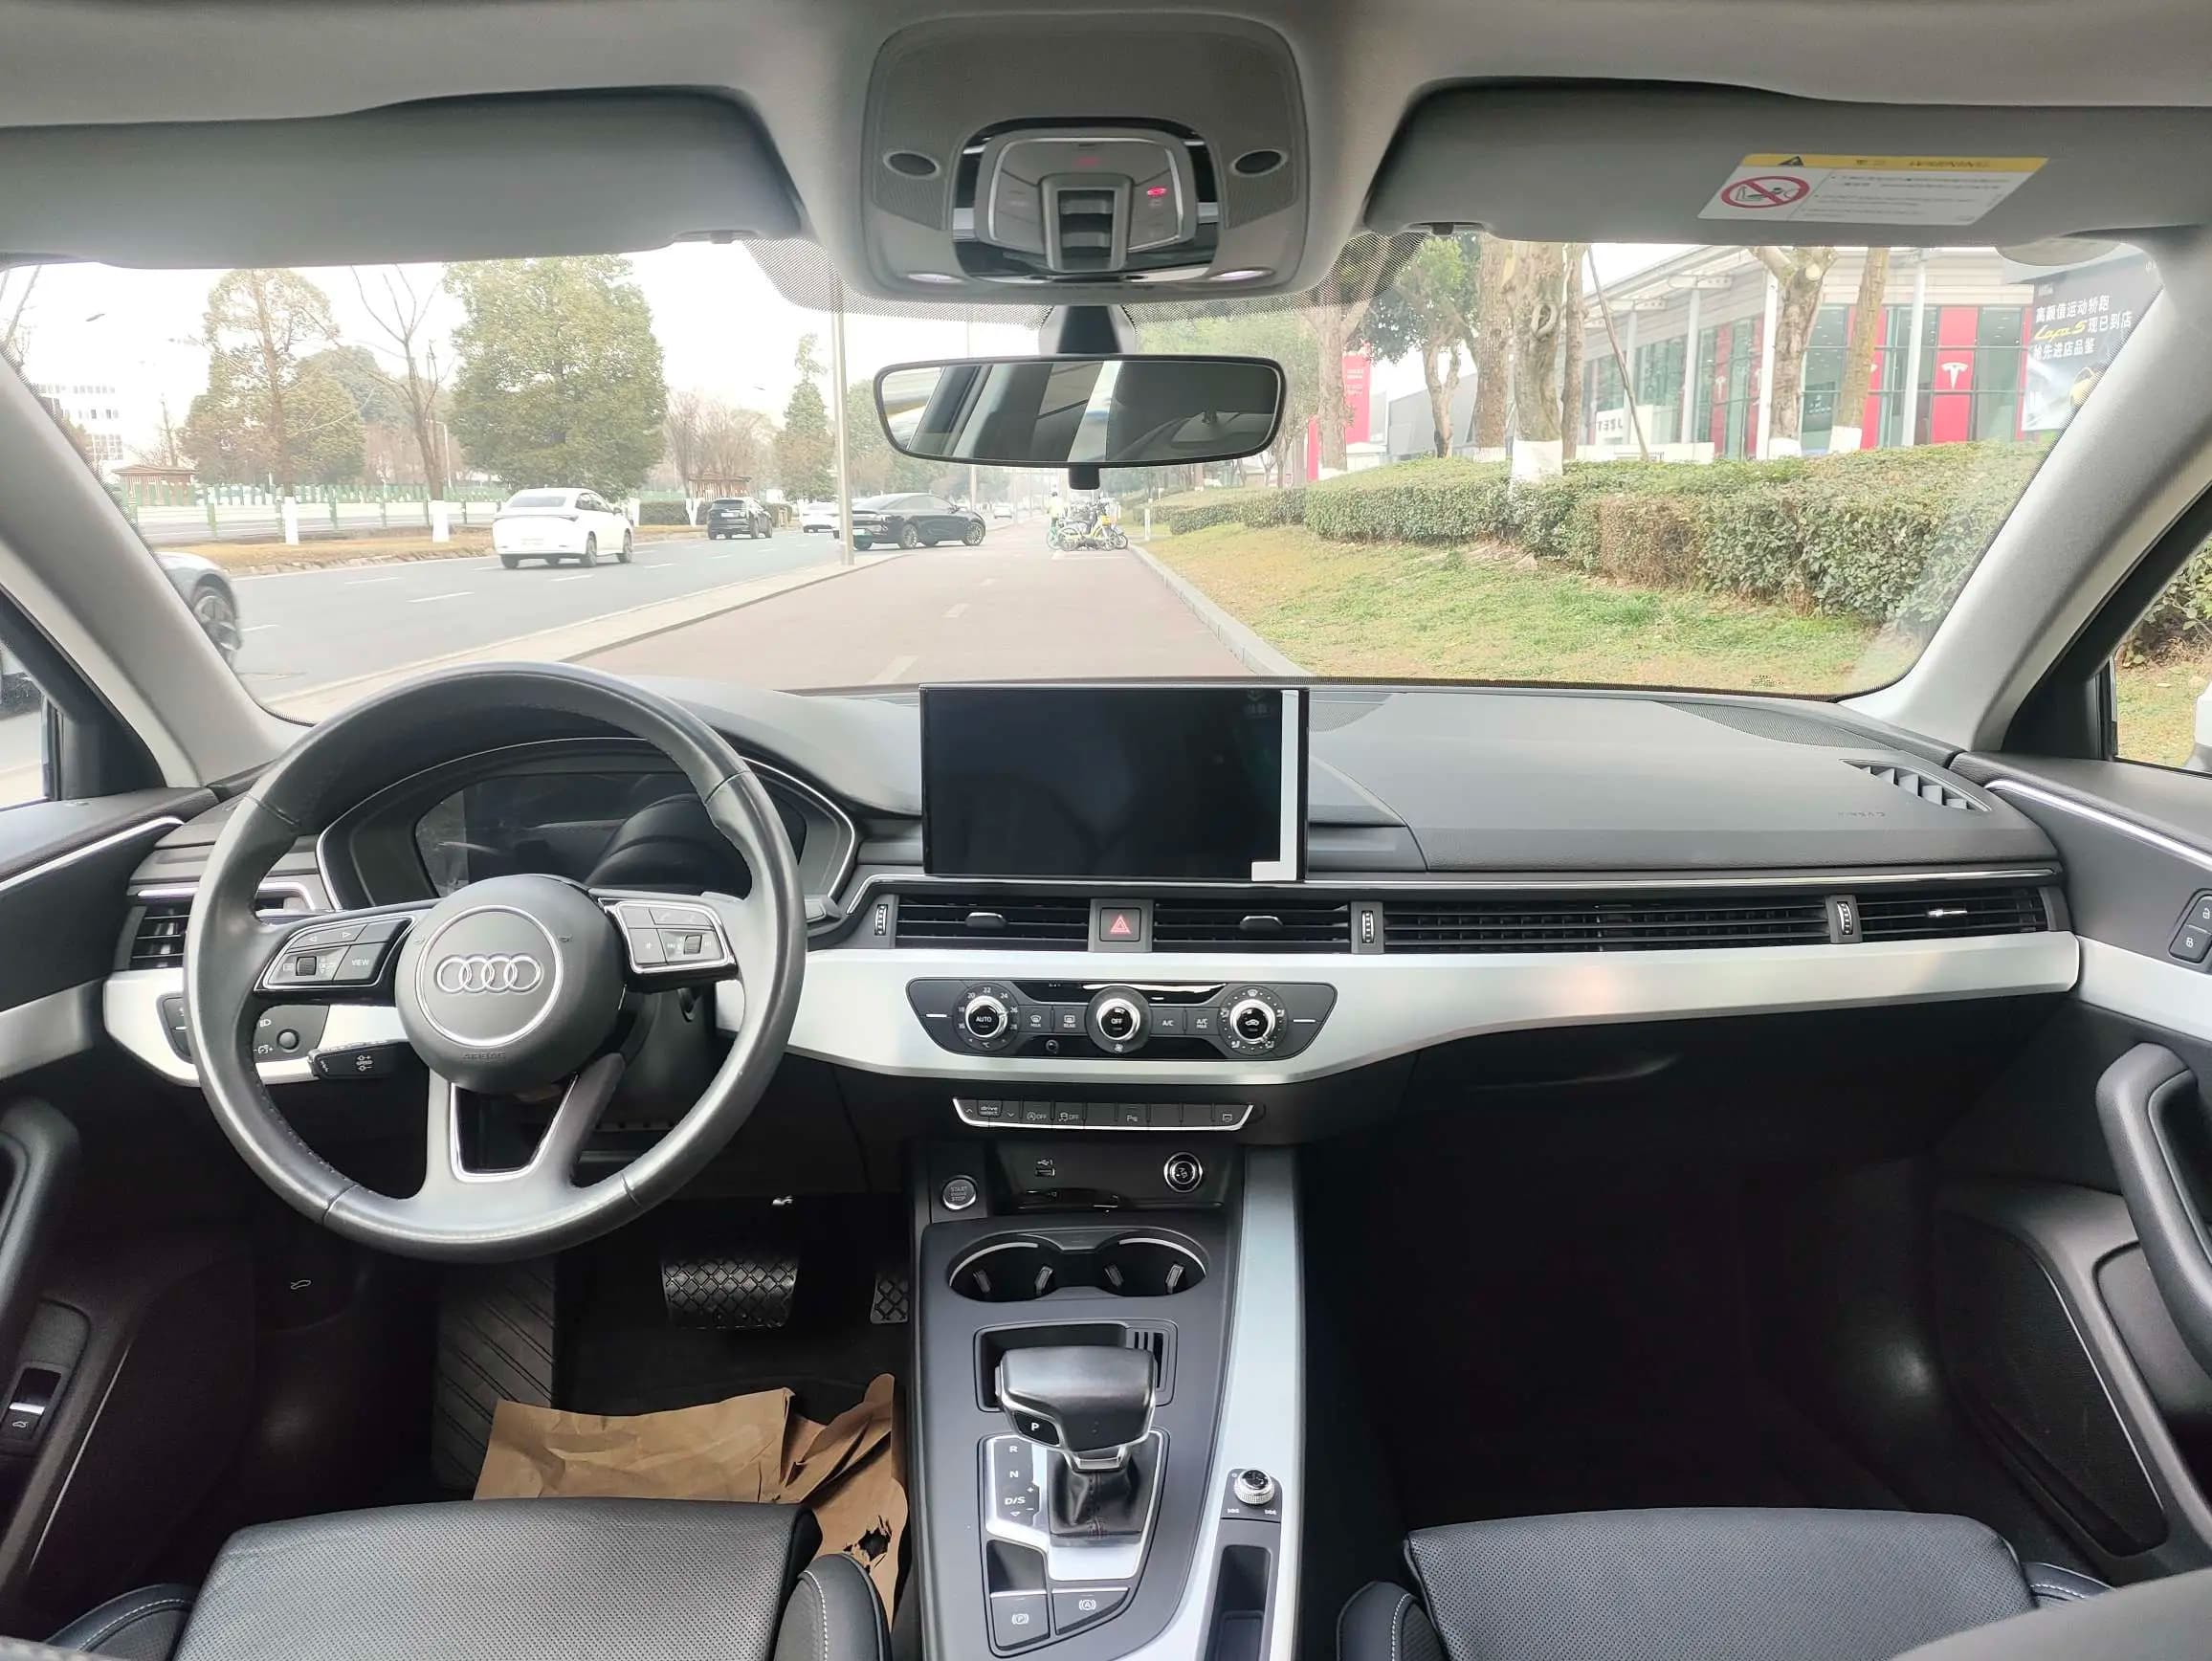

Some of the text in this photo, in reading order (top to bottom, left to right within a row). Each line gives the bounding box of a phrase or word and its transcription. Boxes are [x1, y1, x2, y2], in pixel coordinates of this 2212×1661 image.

[2088, 310, 2134, 333] 现已到店
[1597, 418, 1624, 432] TESL
[1030, 1422, 1040, 1431] P
[1009, 1470, 1019, 1478] N
[1004, 1495, 1026, 1505] D/S
